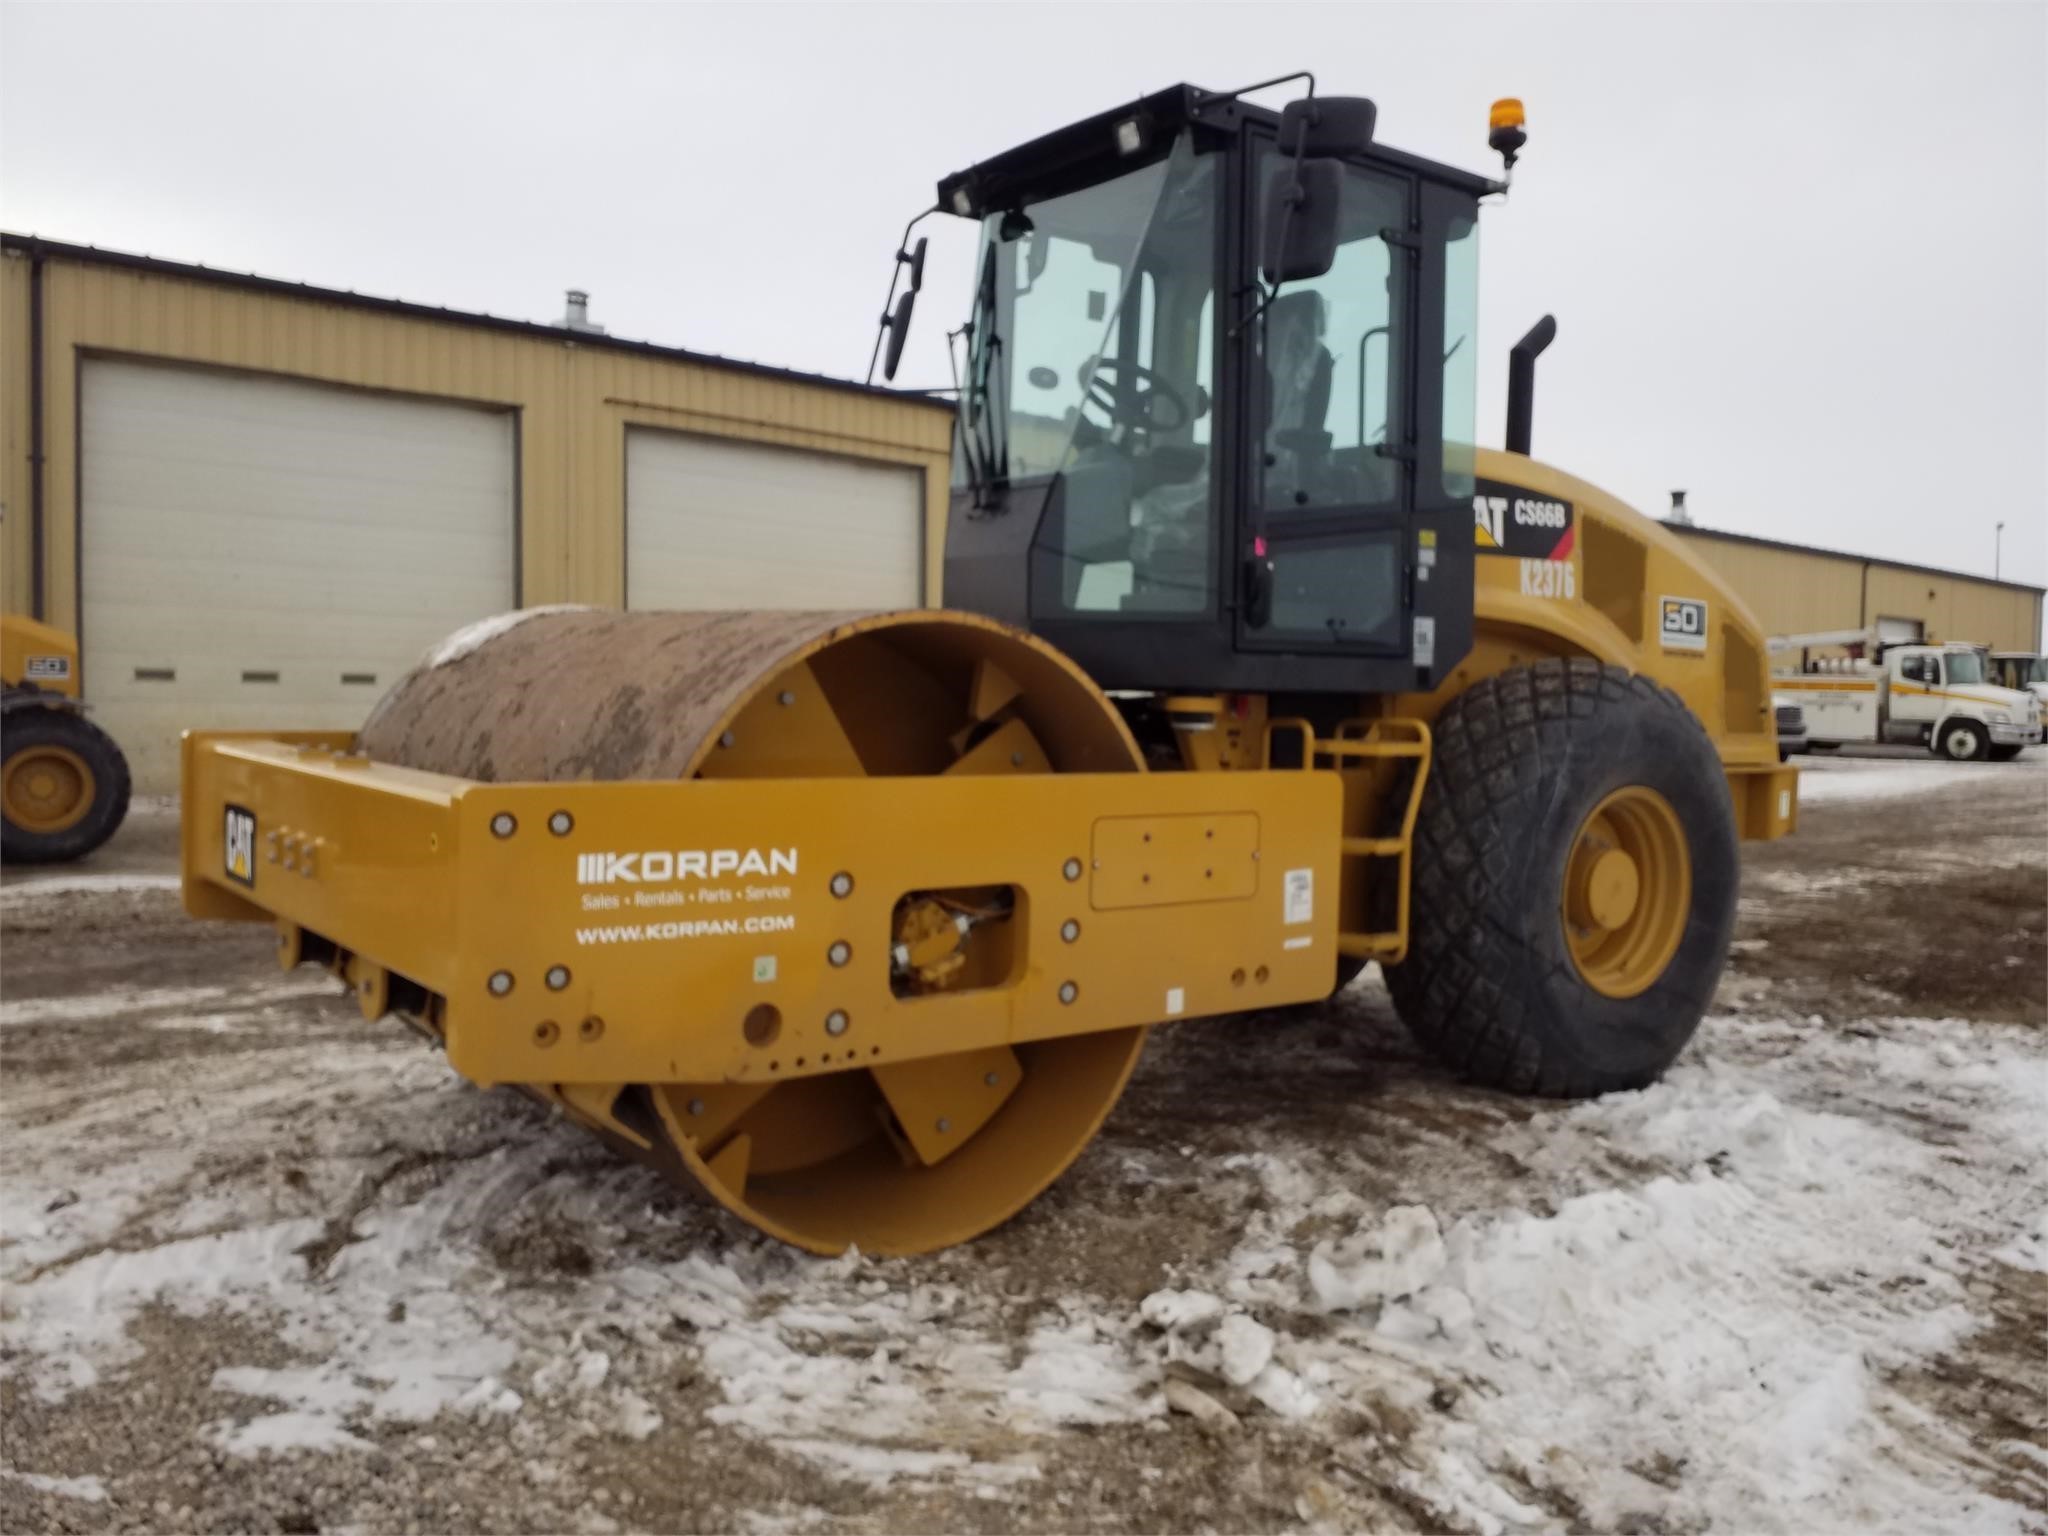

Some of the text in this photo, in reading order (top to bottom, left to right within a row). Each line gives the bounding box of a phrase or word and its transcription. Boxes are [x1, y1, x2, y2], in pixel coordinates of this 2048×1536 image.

[1473, 495, 1566, 548] AT CS66B
[1520, 558, 1575, 600] K2376
[226, 809, 254, 881] CAT
[606, 848, 798, 884] KORPAN
[582, 884, 792, 911] Sales Rentals Parts Service
[576, 915, 795, 945] WWW.KORPAN.COM
